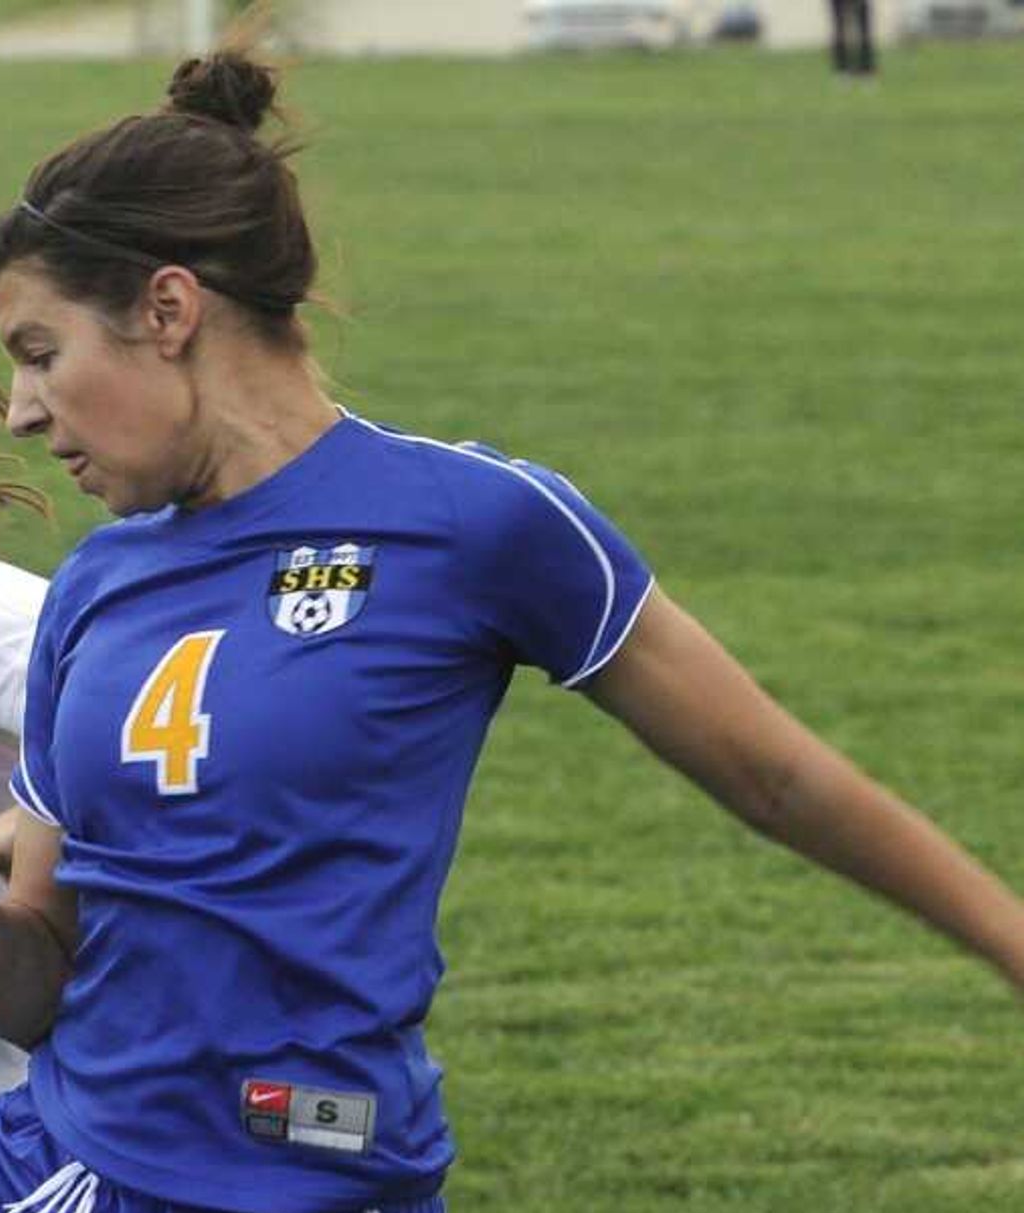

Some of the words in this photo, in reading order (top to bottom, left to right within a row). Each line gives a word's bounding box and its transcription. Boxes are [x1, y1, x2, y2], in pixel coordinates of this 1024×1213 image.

[280, 566, 360, 592] SHS
[120, 629, 227, 795] 4
[316, 1101, 338, 1123] S
